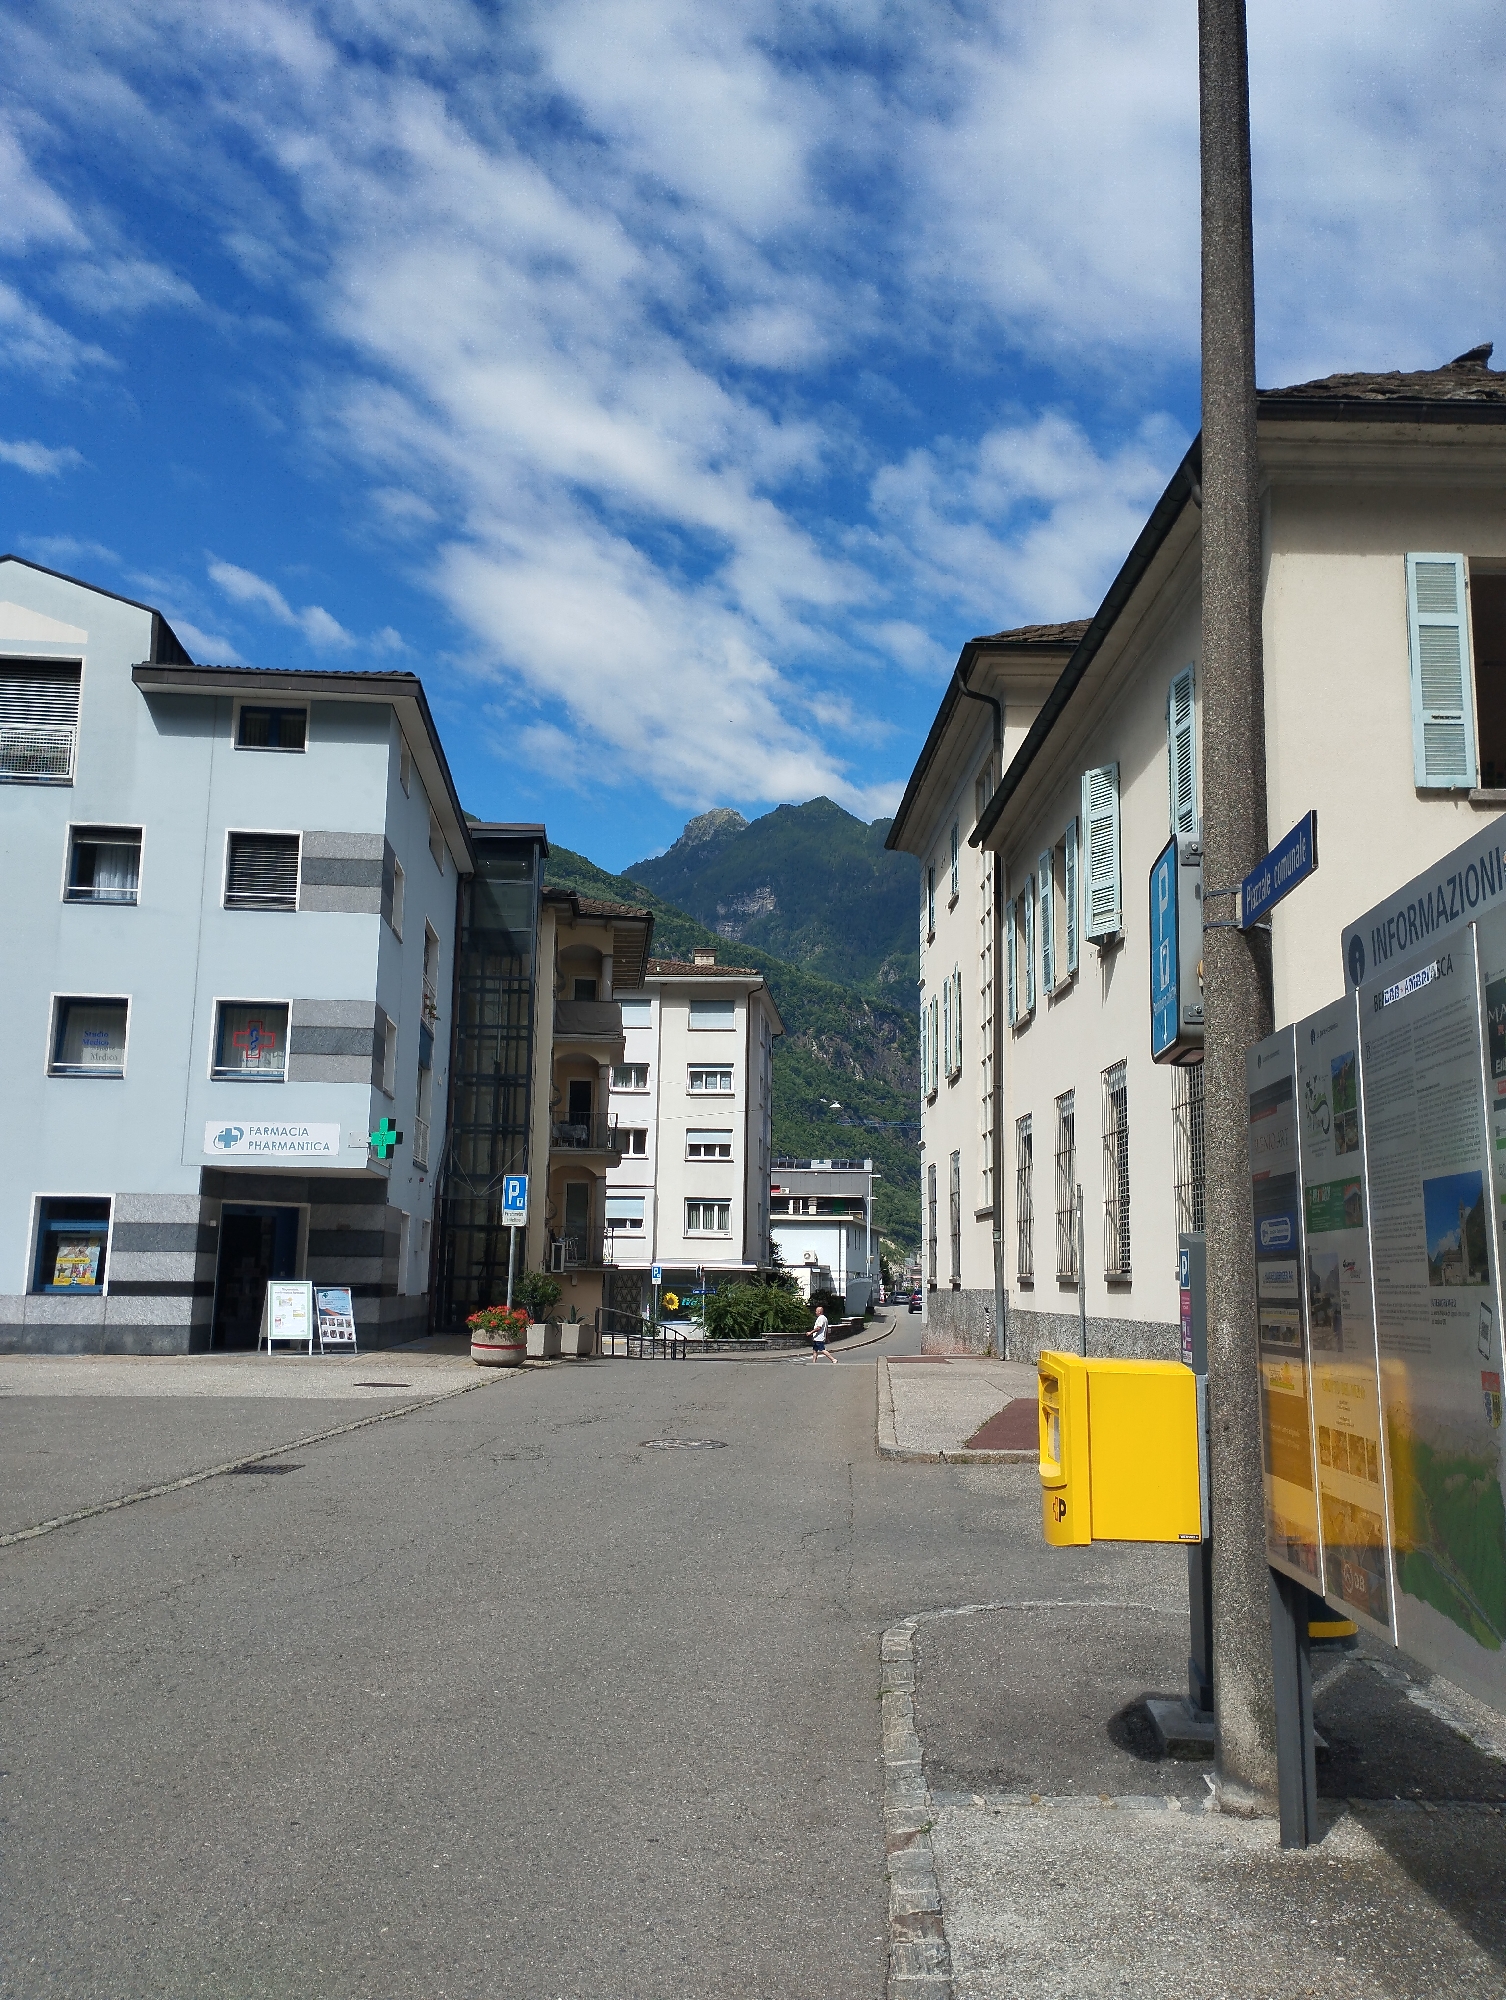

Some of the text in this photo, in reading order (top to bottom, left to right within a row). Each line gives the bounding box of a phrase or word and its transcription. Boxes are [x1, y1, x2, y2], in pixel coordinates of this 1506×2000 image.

[1246, 831, 1306, 916] Piazzale comunale
[1158, 861, 1169, 942] P
[1371, 846, 1504, 967] INFORMAZIONI
[82, 1037, 110, 1046] Medico
[84, 1030, 109, 1038] Studio
[249, 1126, 309, 1137] FARMACIA
[248, 1140, 330, 1151] PHARMANTICA
[508, 1180, 520, 1205] P
[653, 1267, 659, 1277] P
[1181, 1255, 1188, 1284] P
